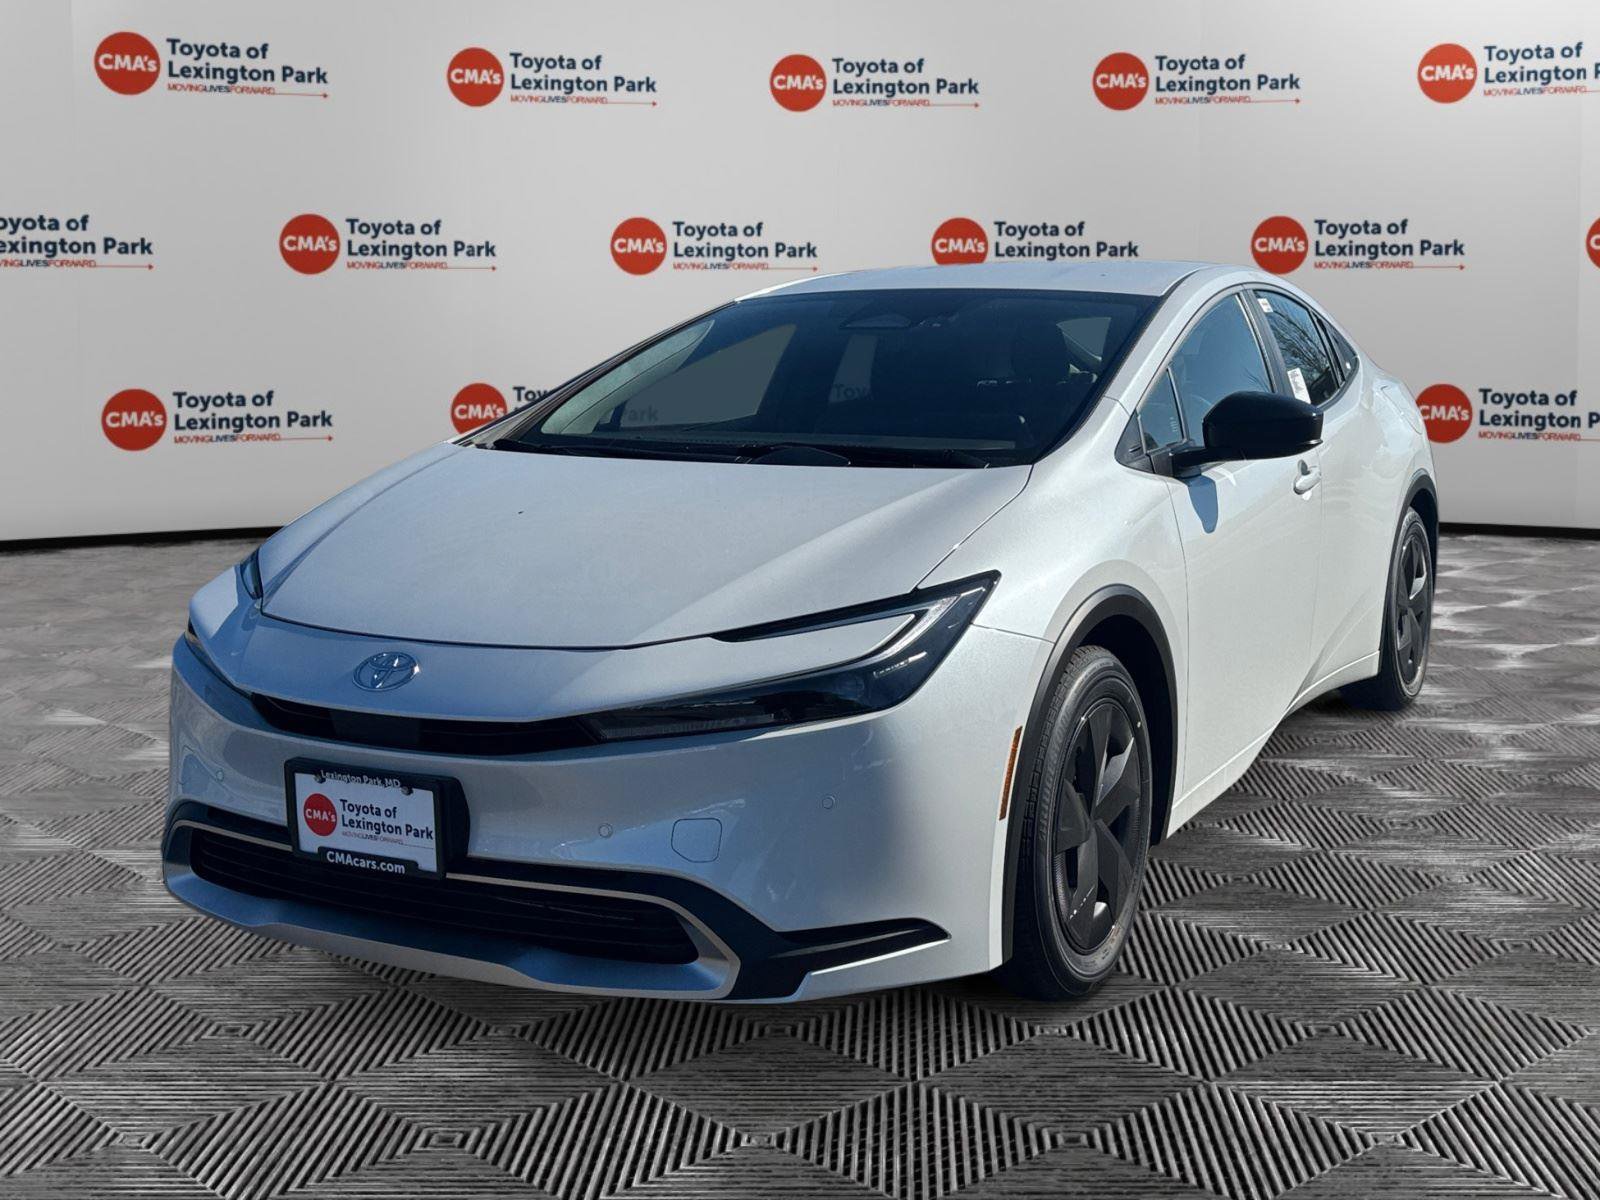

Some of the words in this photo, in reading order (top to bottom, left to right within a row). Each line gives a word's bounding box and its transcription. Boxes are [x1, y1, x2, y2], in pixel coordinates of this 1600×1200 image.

[166, 38, 240, 61] Toyota
[246, 43, 268, 59] of
[1485, 45, 1554, 64] Toyota
[1561, 42, 1582, 58] of
[99, 54, 158, 73] CMA's
[510, 53, 576, 73] Toyota
[582, 55, 601, 70] of
[832, 58, 898, 77] Toyota
[904, 58, 924, 73] of
[1155, 56, 1219, 75] Toyota
[1225, 54, 1245, 69] of
[168, 61, 275, 85] Lexington
[282, 65, 328, 84] Park
[450, 68, 502, 85] CMA's
[773, 75, 825, 90] CMA's
[1096, 74, 1146, 88] CMA's
[1420, 64, 1475, 82] CMA's
[1485, 66, 1586, 85] Lexington
[511, 74, 607, 95] Lexington
[614, 76, 655, 92] Park
[834, 79, 929, 98] Lexington
[937, 78, 979, 94] Park
[1156, 76, 1250, 95] Lexington
[1258, 74, 1299, 90] Park
[66, 215, 89, 231] of
[346, 218, 415, 239] Toyota
[421, 220, 441, 235] of
[673, 221, 738, 241] Toyota
[743, 222, 763, 237] of
[994, 221, 1059, 241] Toyota
[1064, 221, 1085, 236] of
[1314, 220, 1381, 239] Toyota
[1387, 219, 1408, 235] of
[103, 237, 153, 255] Park
[284, 236, 336, 251] CMA's
[348, 240, 447, 261] Lexington
[454, 241, 495, 257] Park
[614, 238, 664, 253] CMA's
[674, 242, 768, 261] Lexington
[775, 242, 817, 258] Park
[935, 239, 985, 253] CMA's
[995, 241, 1090, 261] Lexington
[1097, 241, 1138, 257] Park
[1255, 238, 1305, 252] CMA's
[1315, 240, 1413, 260] Lexington
[1420, 239, 1464, 256] Park
[172, 392, 246, 412] Toyota
[252, 390, 274, 407] of
[1478, 388, 1549, 409] Toyota
[1554, 390, 1577, 406] of
[106, 412, 163, 427] CMA's
[454, 403, 505, 419] CMA's
[626, 405, 658, 421] ark
[1419, 405, 1469, 421] CMA's
[1479, 409, 1581, 432] Lexington
[174, 412, 280, 433] Lexington
[287, 410, 332, 428] Park
[320, 770, 362, 784] Lexington
[385, 778, 401, 788] MD
[305, 808, 337, 822] CMA's
[339, 799, 381, 816] Toyota
[384, 807, 397, 818] of
[342, 814, 402, 835] Lexington
[405, 823, 433, 840] Park
[326, 850, 405, 874] CMAcars.com
